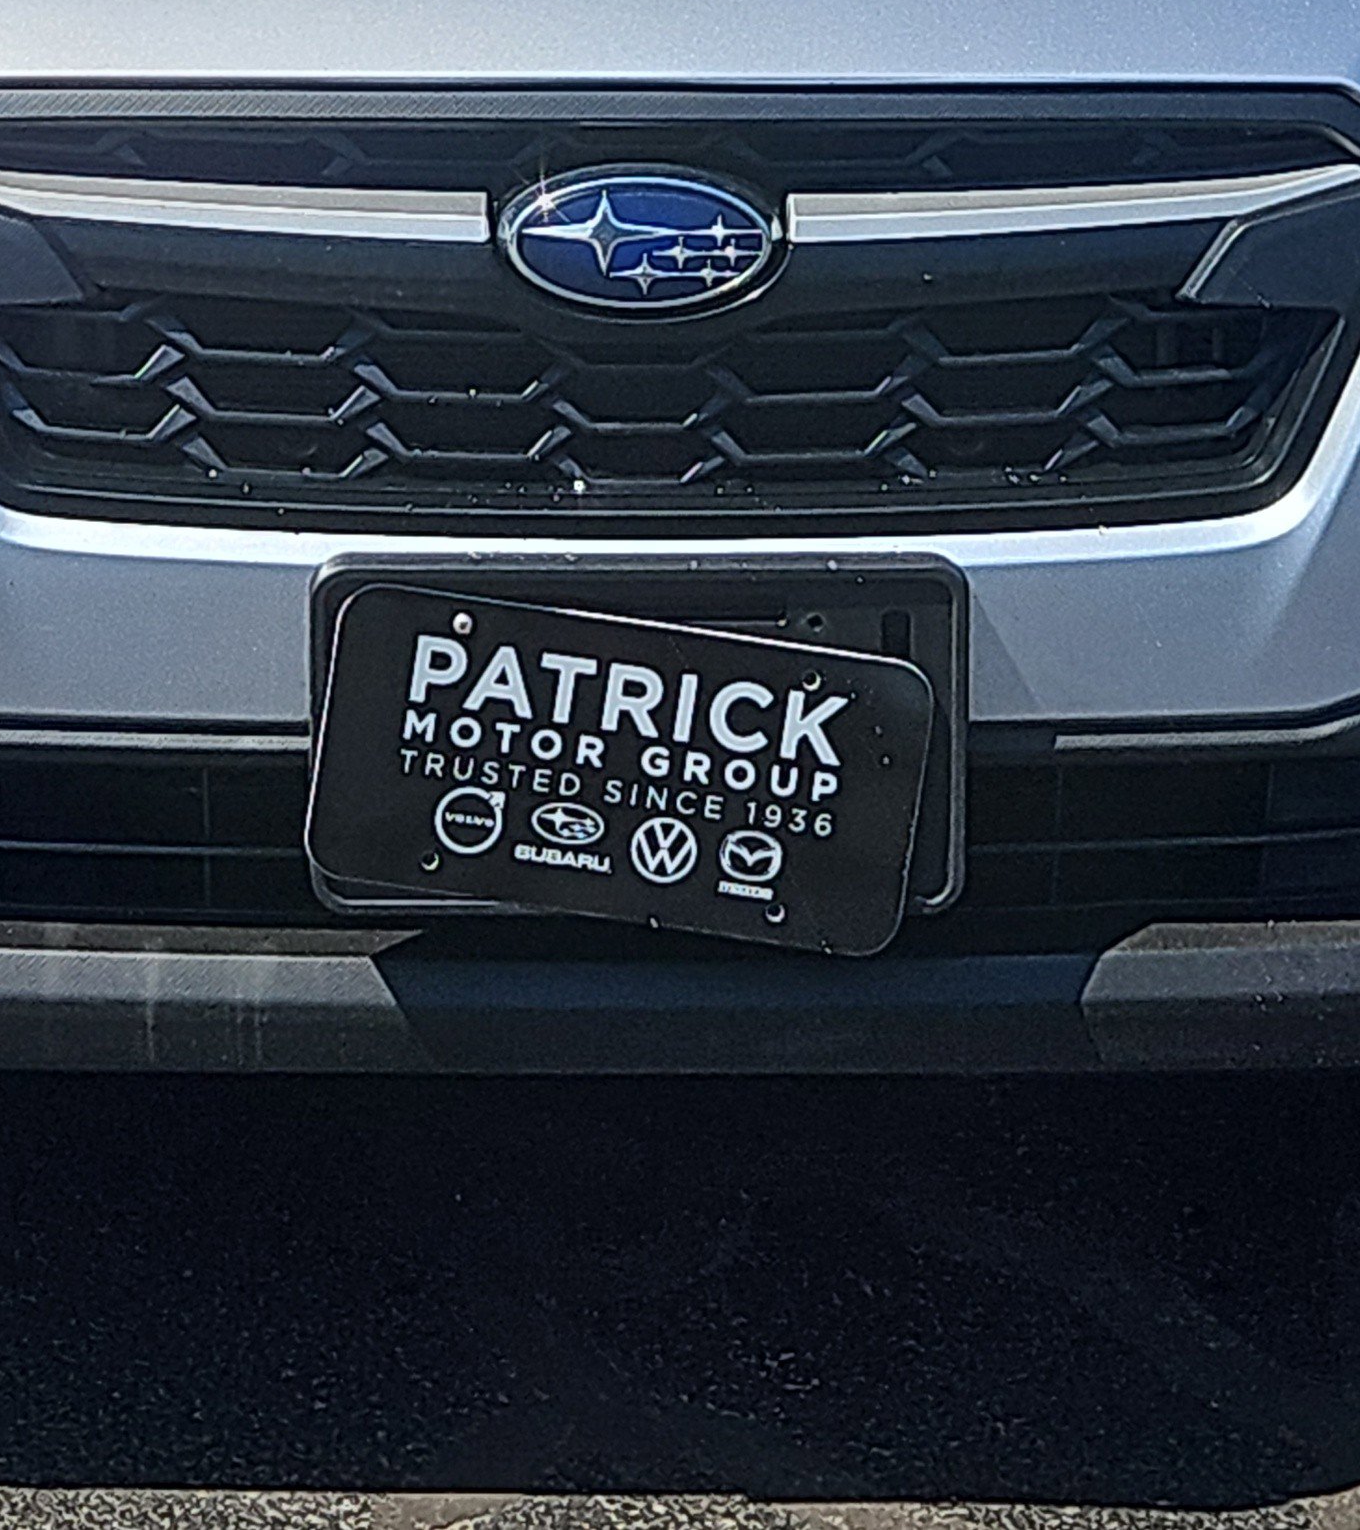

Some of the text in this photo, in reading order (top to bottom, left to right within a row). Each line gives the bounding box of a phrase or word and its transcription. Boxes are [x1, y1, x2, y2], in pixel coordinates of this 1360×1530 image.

[408, 634, 850, 767] PATRICK
[399, 747, 833, 838] TRUSTED SINCE 1936
[400, 708, 838, 803] MOTOR GROUP
[444, 811, 495, 828] VOLVO
[513, 843, 612, 873] SUBARU
